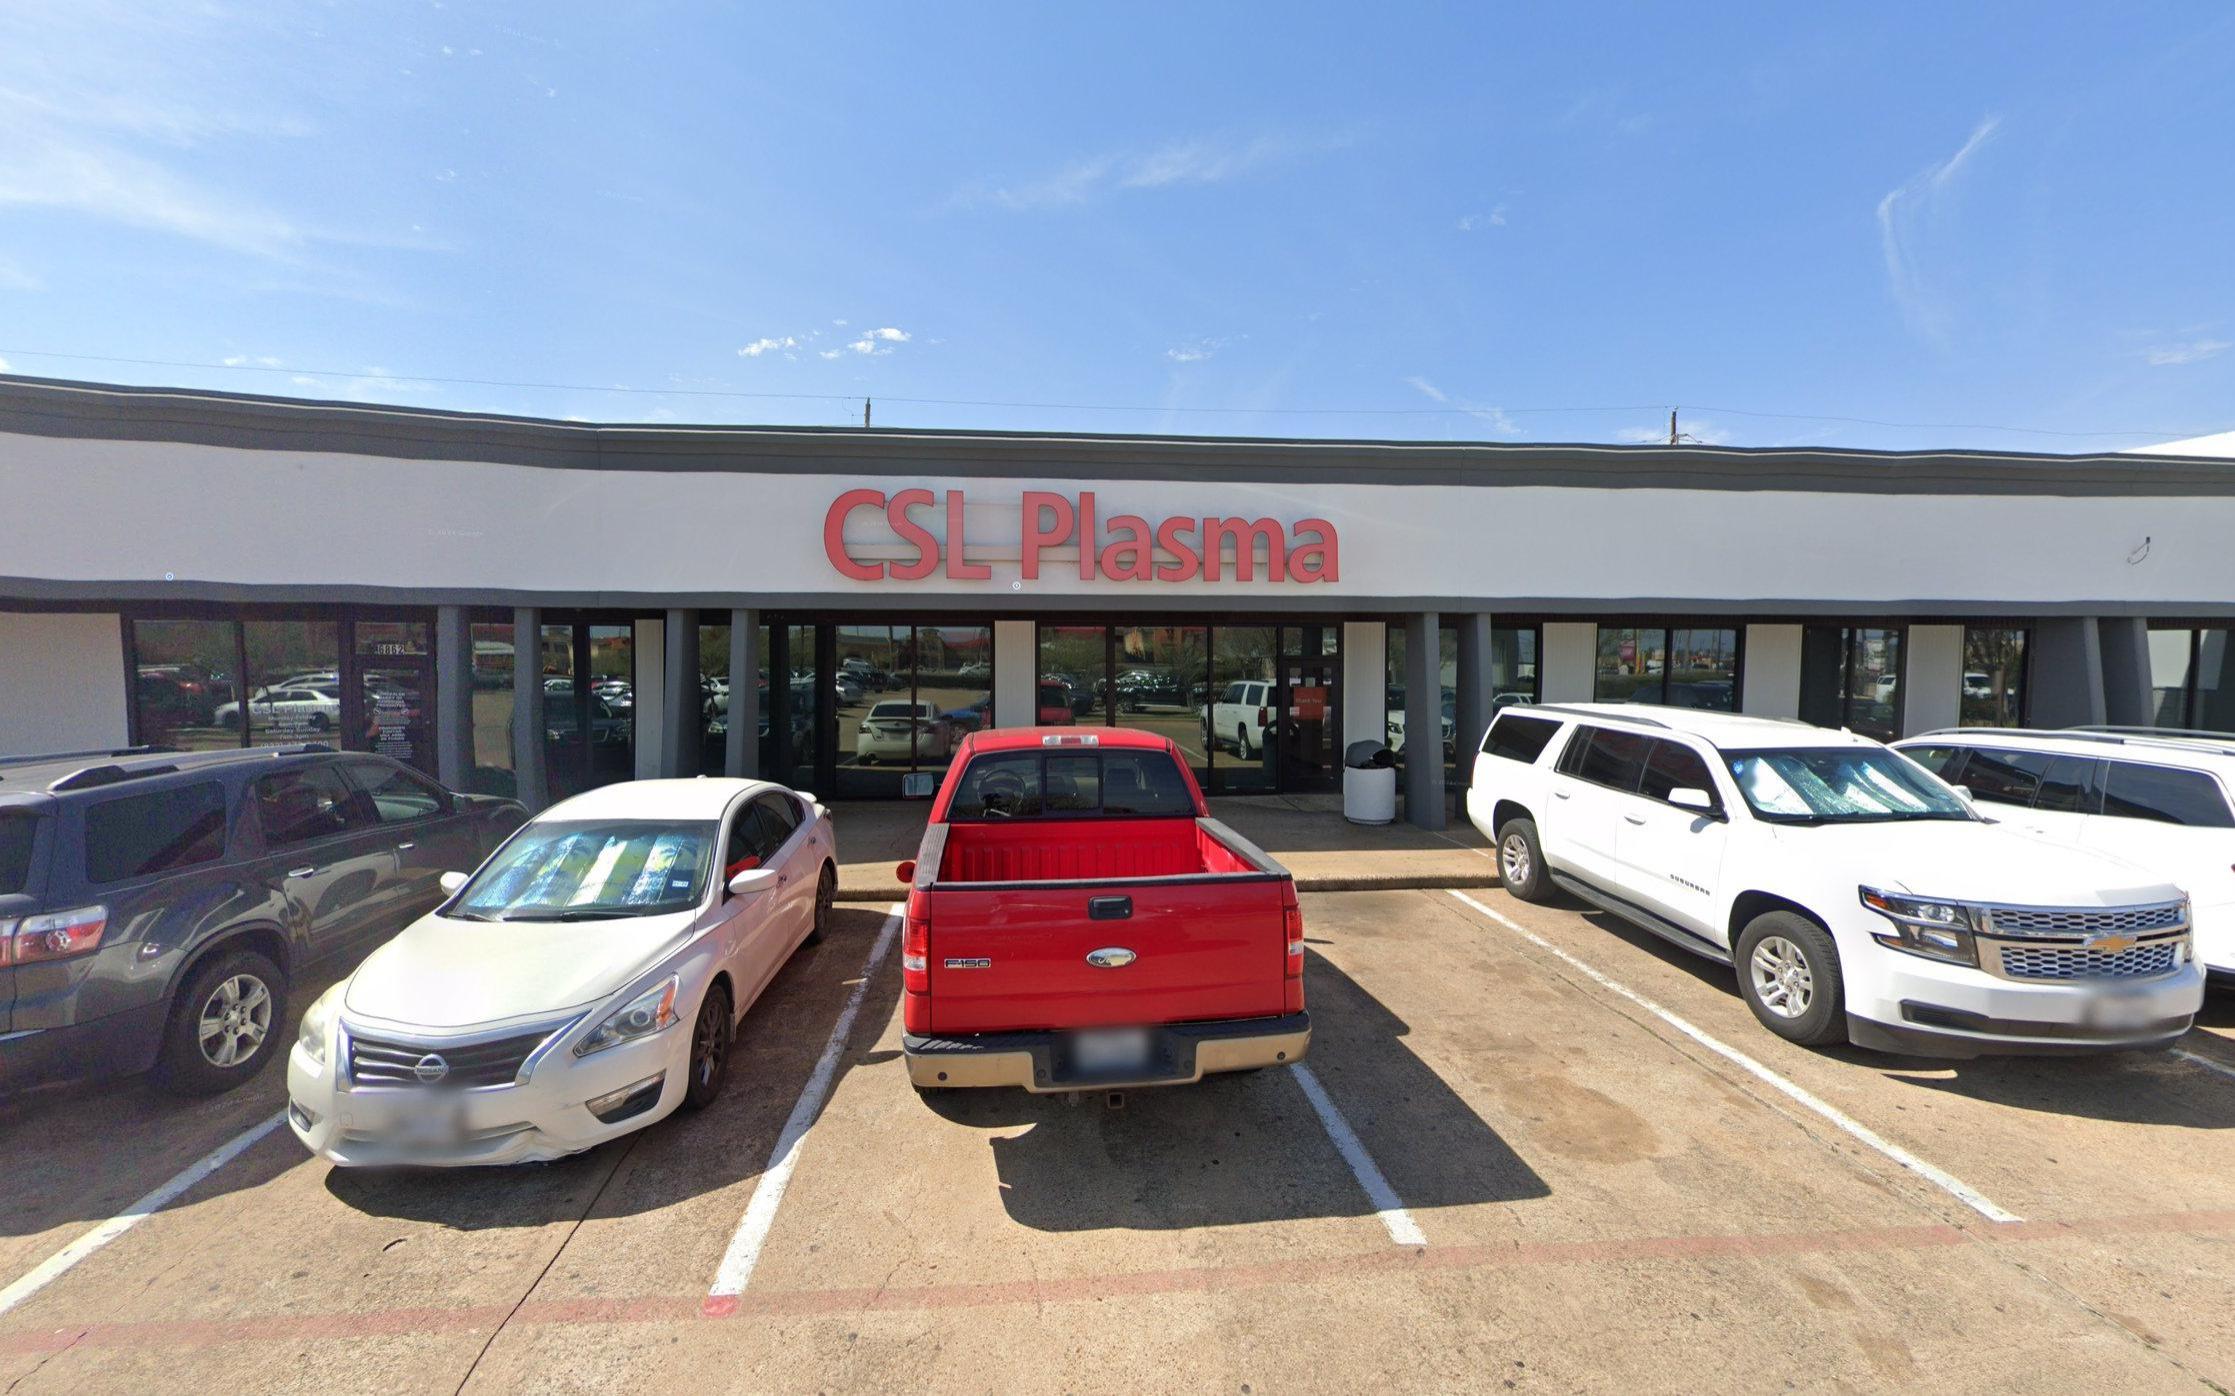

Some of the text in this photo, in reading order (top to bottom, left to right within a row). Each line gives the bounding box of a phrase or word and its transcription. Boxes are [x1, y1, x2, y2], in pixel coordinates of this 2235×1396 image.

[823, 488, 1340, 585] CSL Plasma
[378, 643, 404, 655] 6862
[1670, 874, 1711, 896] SUBURBAN
